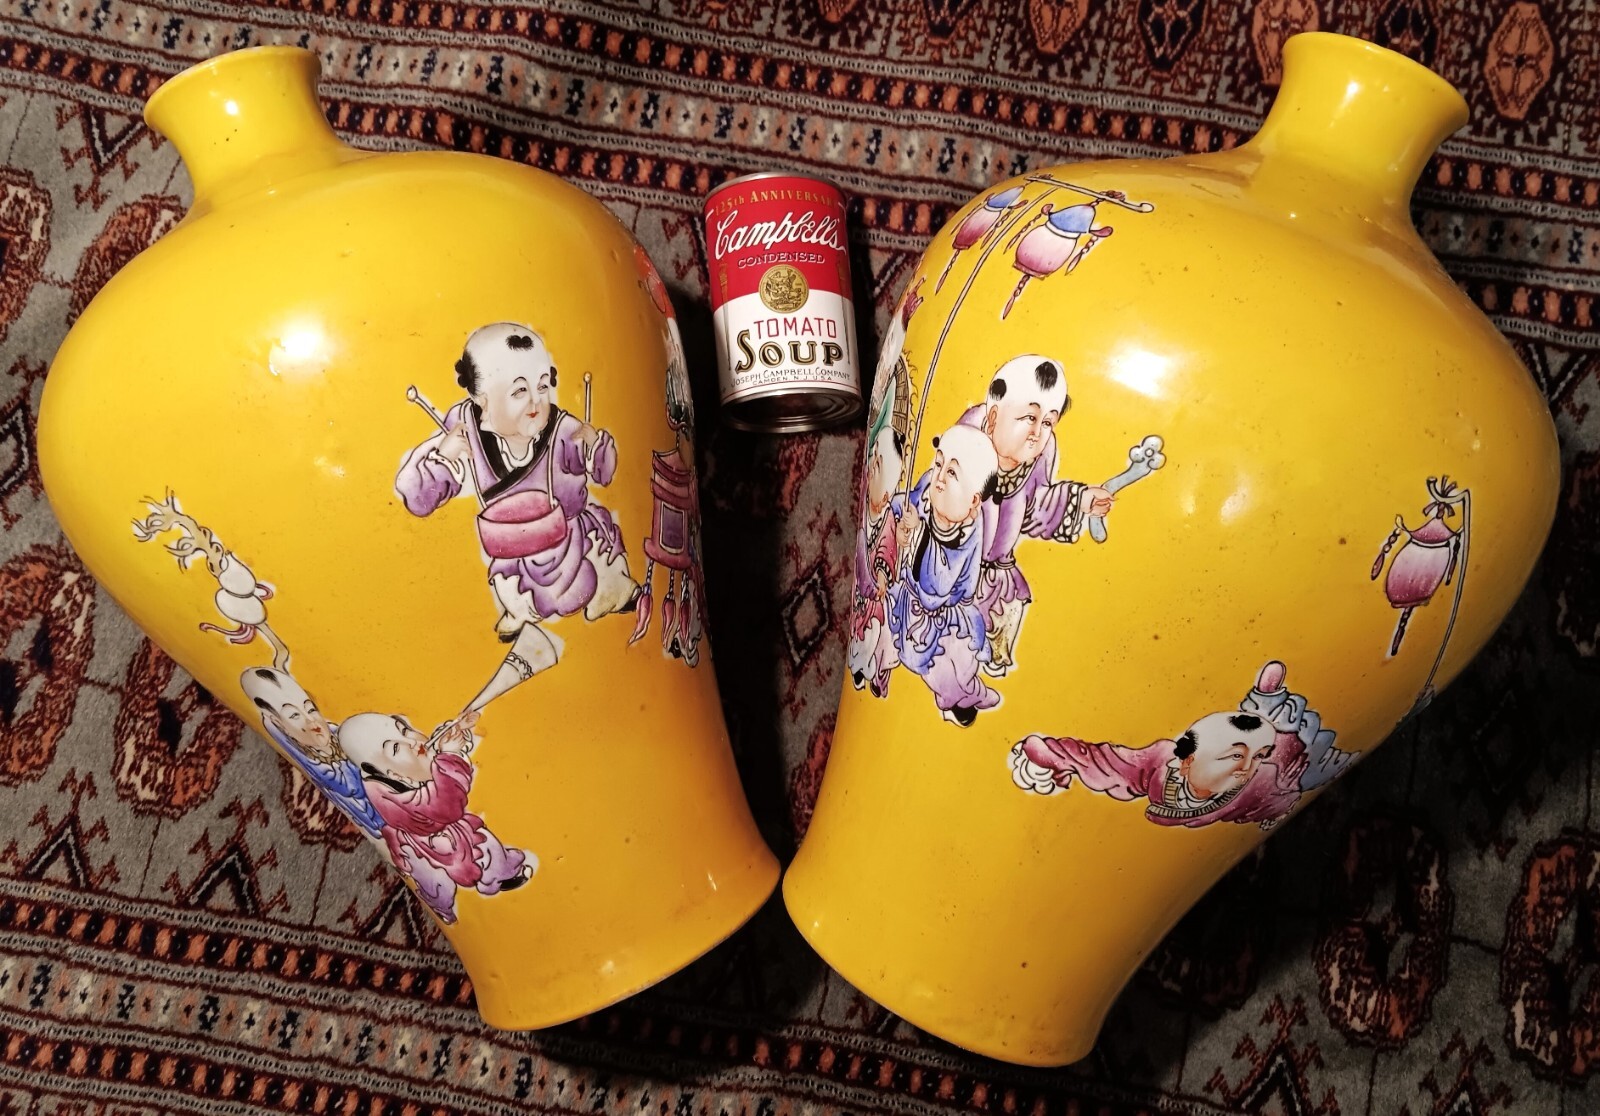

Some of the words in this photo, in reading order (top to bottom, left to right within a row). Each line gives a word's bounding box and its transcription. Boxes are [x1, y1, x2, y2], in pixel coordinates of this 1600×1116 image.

[738, 252, 826, 269] CONDENSED
[753, 316, 838, 340] TOMATO
[734, 328, 844, 375] SOUP
[731, 373, 761, 387] JOSEPH
[763, 368, 814, 379] CAMPBELL
[815, 366, 851, 381] COMPANY
